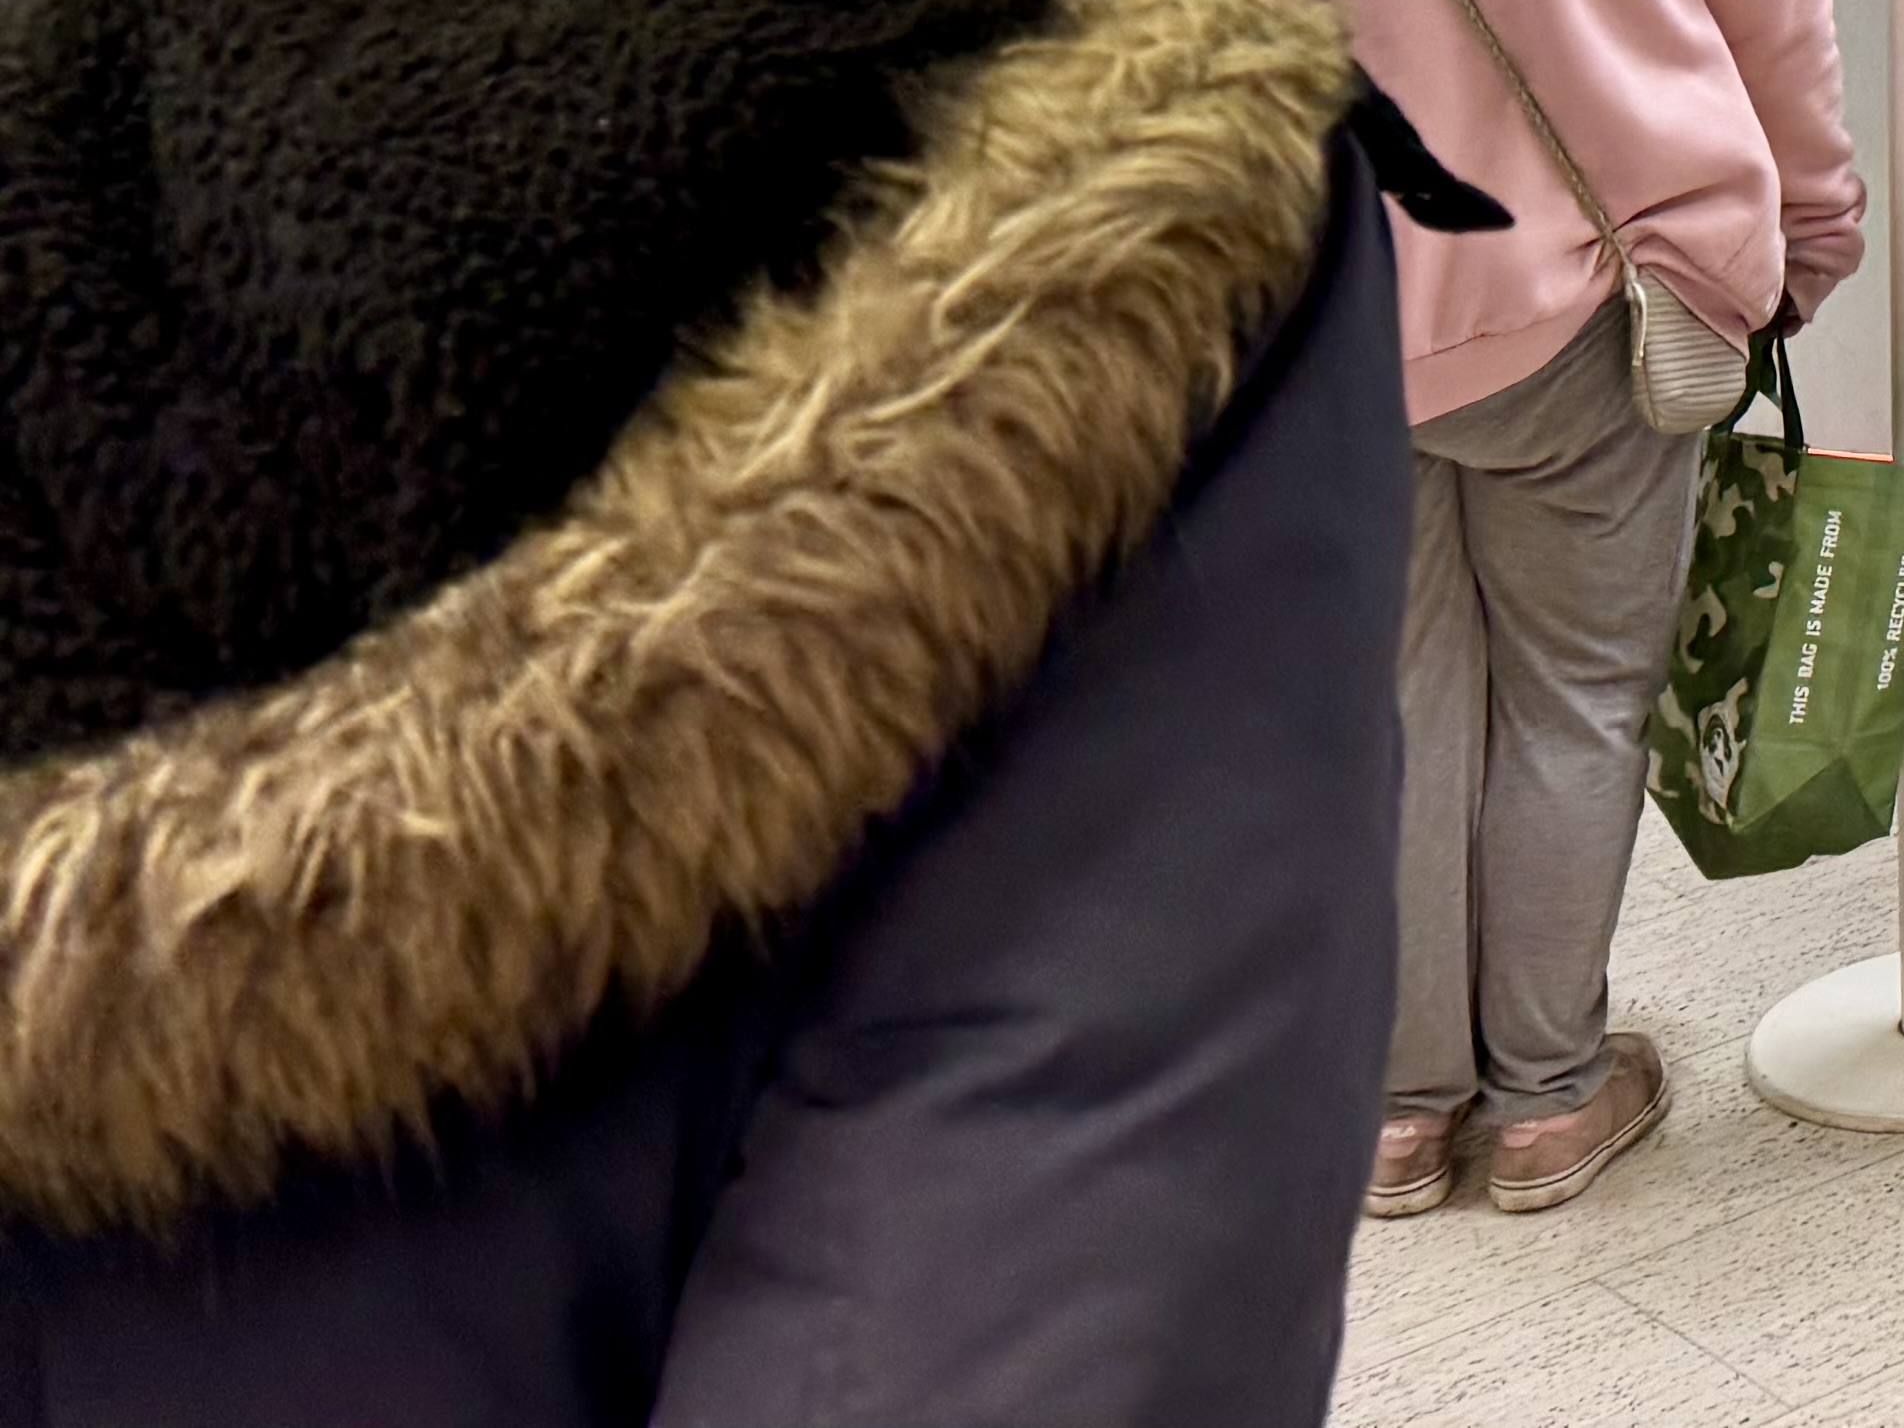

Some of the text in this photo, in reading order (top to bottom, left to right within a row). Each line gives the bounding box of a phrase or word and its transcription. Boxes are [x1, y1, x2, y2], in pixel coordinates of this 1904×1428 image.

[1820, 510, 1842, 558] FROM
[1810, 564, 1832, 614] MADE
[1806, 620, 1821, 636] IS
[1877, 648, 1898, 690] 100%
[1789, 686, 1809, 724] THIS
